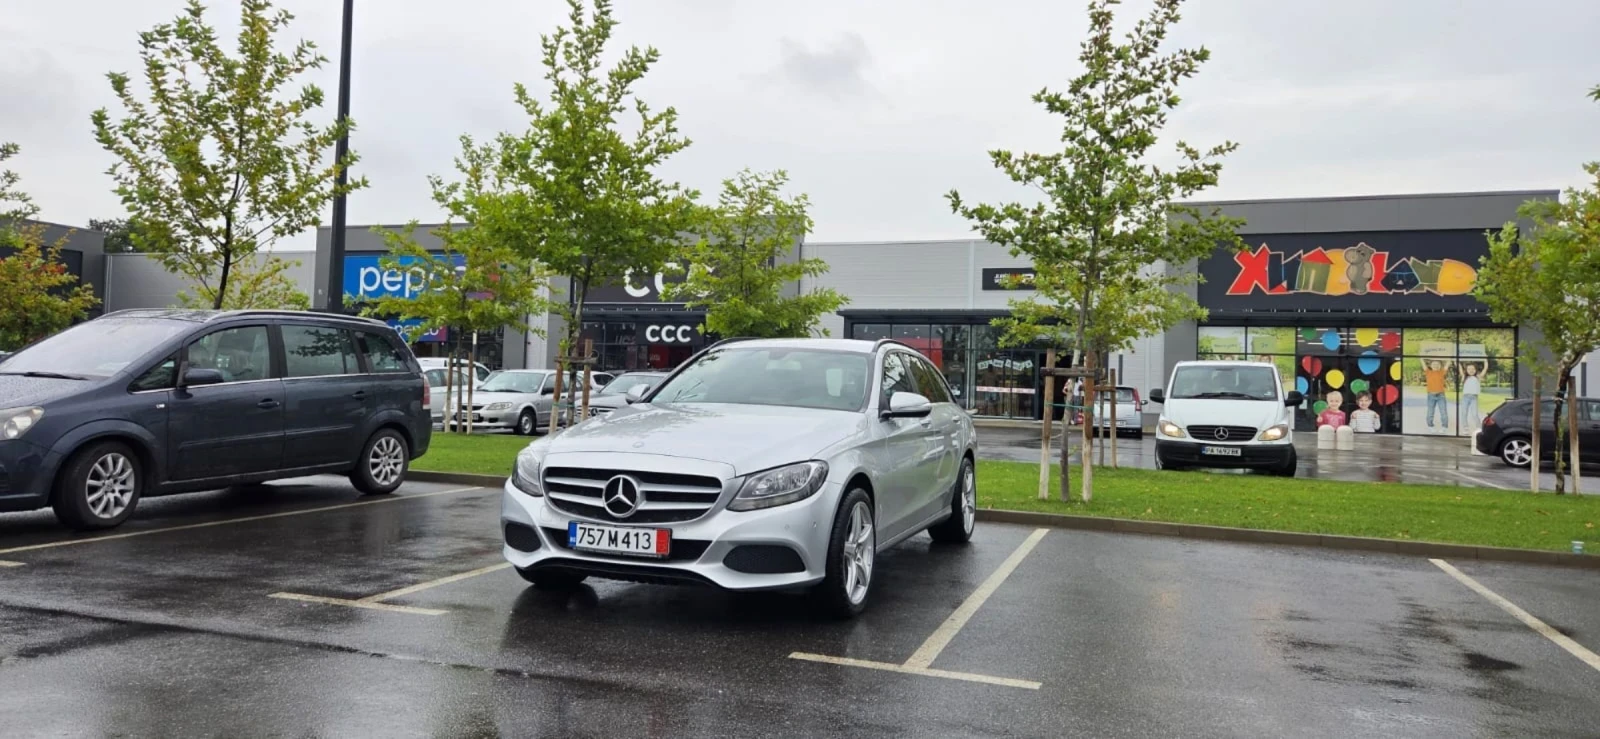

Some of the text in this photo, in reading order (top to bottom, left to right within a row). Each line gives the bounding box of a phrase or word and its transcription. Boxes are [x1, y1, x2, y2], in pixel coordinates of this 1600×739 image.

[394, 324, 440, 337] peo
[645, 324, 692, 343] CCC
[578, 526, 605, 546] 757
[621, 531, 652, 550] 413
